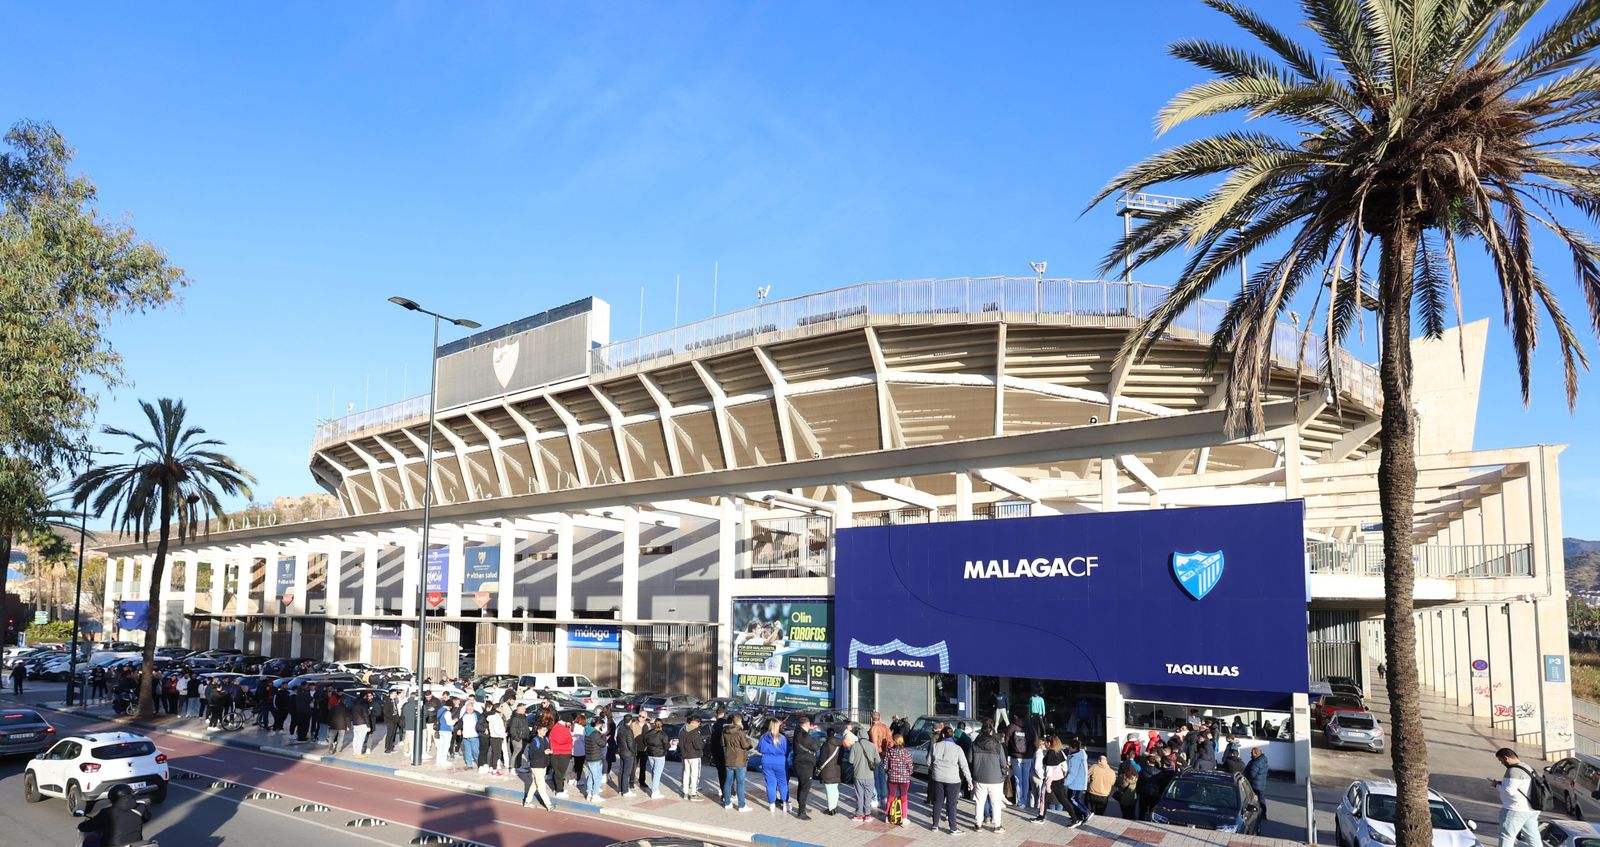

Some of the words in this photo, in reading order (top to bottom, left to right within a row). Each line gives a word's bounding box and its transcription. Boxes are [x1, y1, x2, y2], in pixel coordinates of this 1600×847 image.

[964, 557, 1099, 578] MALAGACF
[791, 611, 812, 623] Olin
[789, 626, 826, 641] FOROFOS
[870, 658, 895, 667] TIENDA
[897, 659, 925, 668] OFICIAL
[789, 664, 802, 676] 15
[810, 665, 823, 677] 19
[1165, 663, 1240, 677] TAQUILLAS
